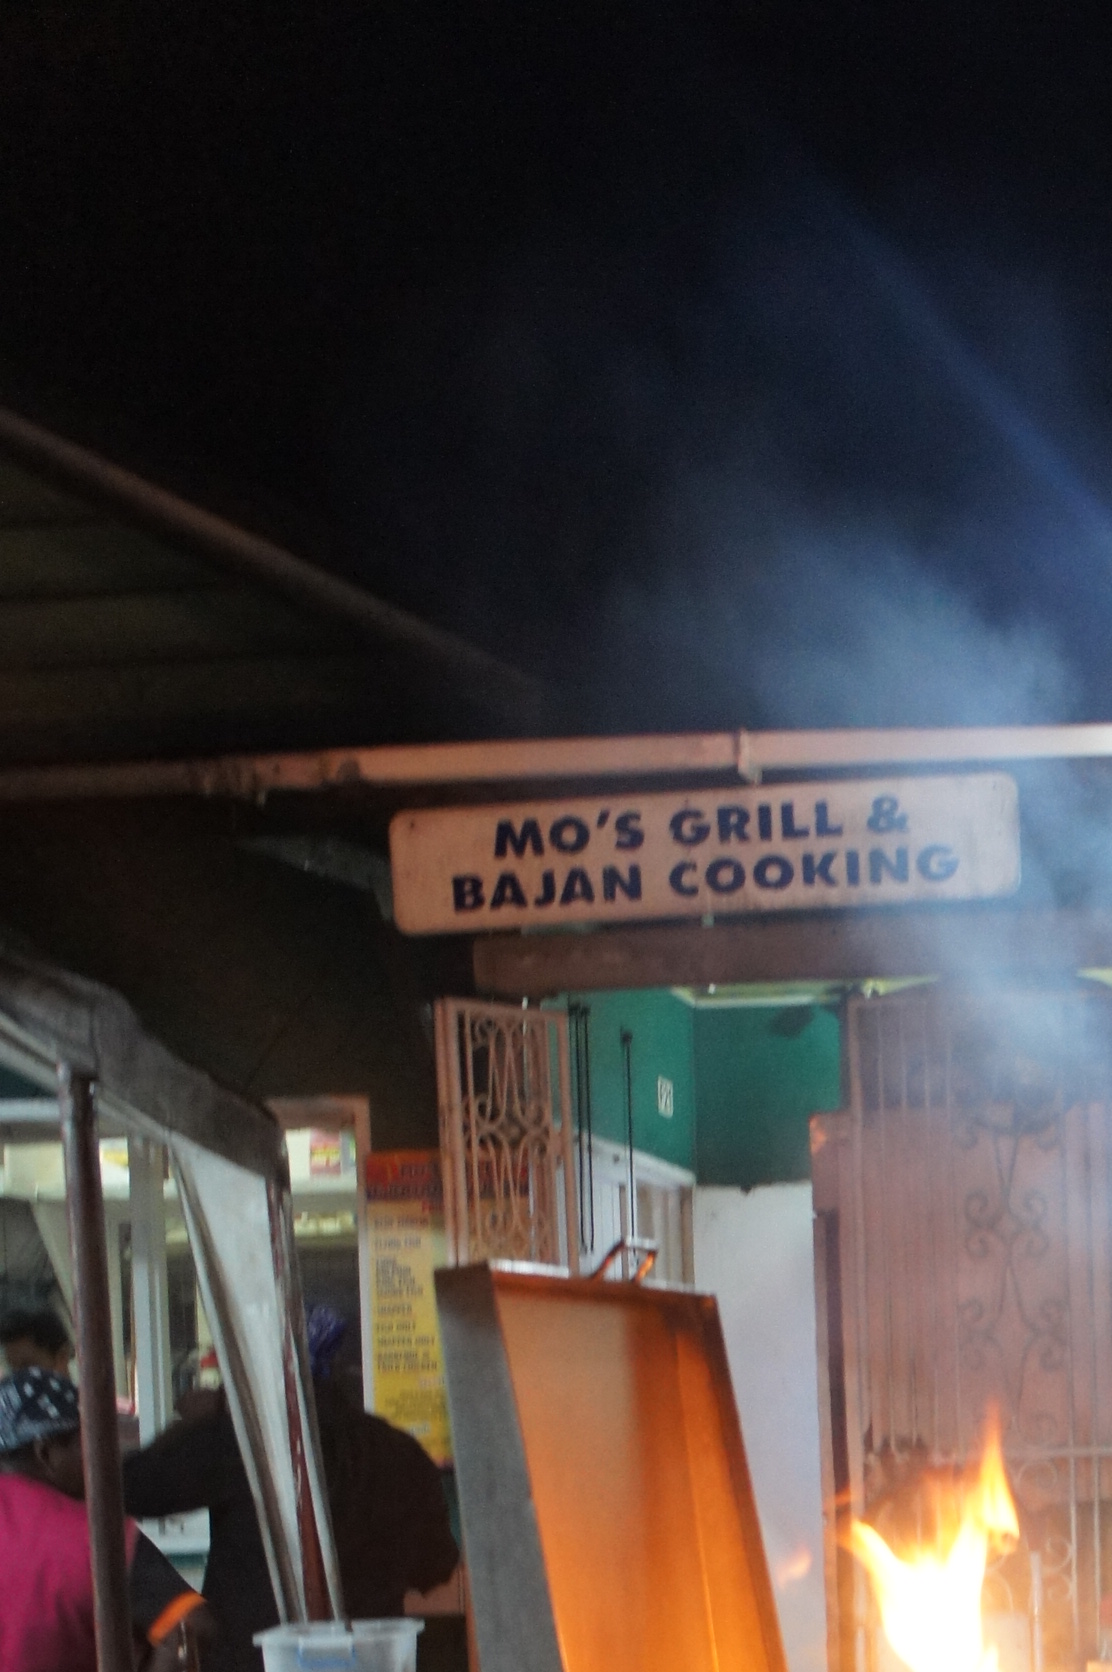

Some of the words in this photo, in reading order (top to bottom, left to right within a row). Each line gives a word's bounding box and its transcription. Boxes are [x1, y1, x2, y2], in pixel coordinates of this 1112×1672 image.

[493, 808, 645, 859] MO'S
[669, 798, 844, 847] GRILL
[866, 793, 909, 833] &
[452, 863, 643, 913] BAJAN
[668, 843, 960, 897] COOKING
